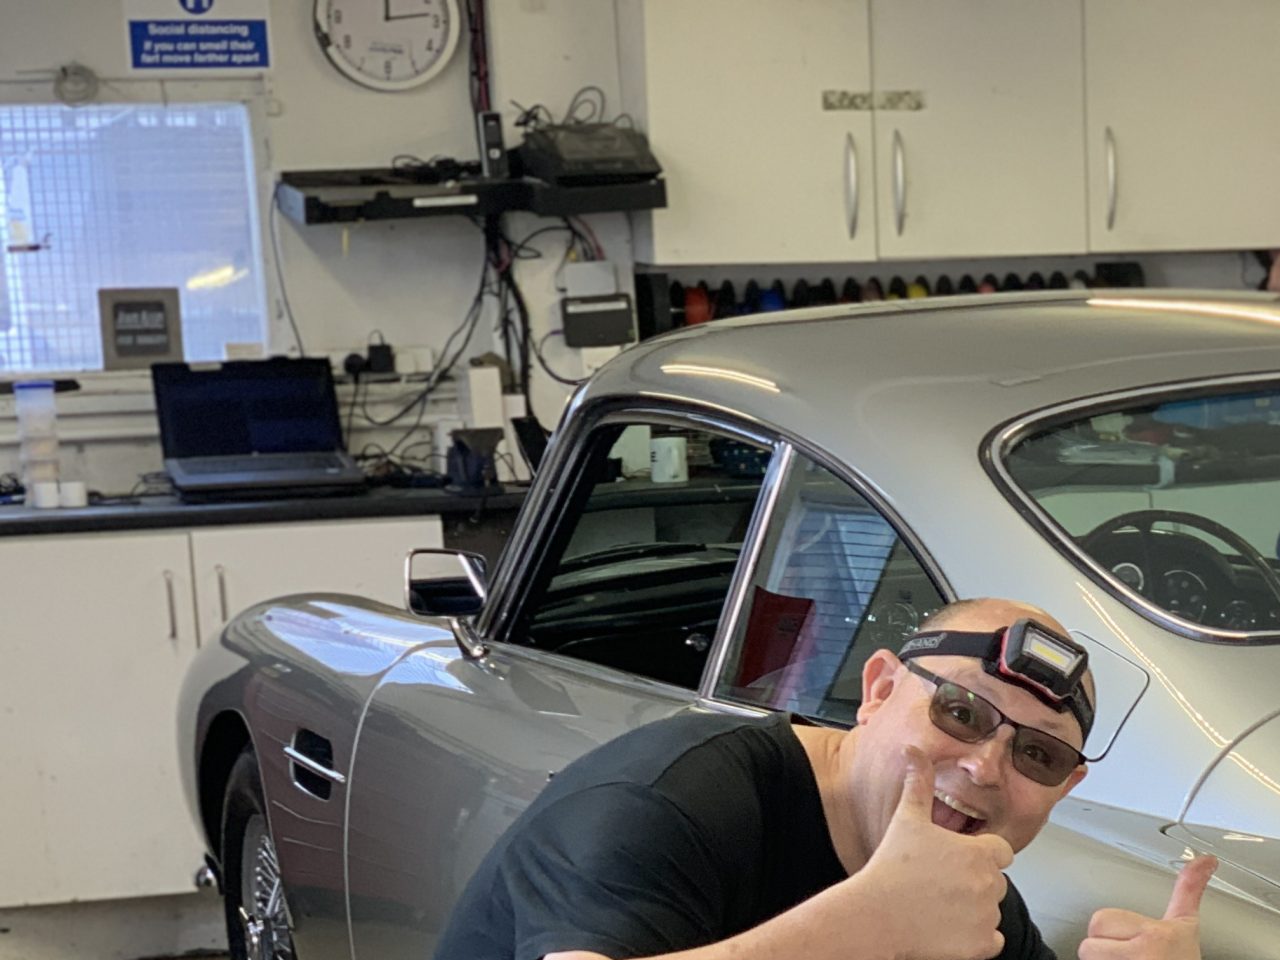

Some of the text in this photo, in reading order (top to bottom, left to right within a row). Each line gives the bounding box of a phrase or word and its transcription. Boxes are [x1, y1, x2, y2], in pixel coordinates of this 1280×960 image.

[147, 23, 249, 38] Social distancing
[153, 42, 175, 53] you
[176, 42, 197, 51] can
[198, 40, 229, 51] smell
[230, 40, 255, 51] their
[161, 53, 192, 63] move
[231, 52, 260, 64] apart
